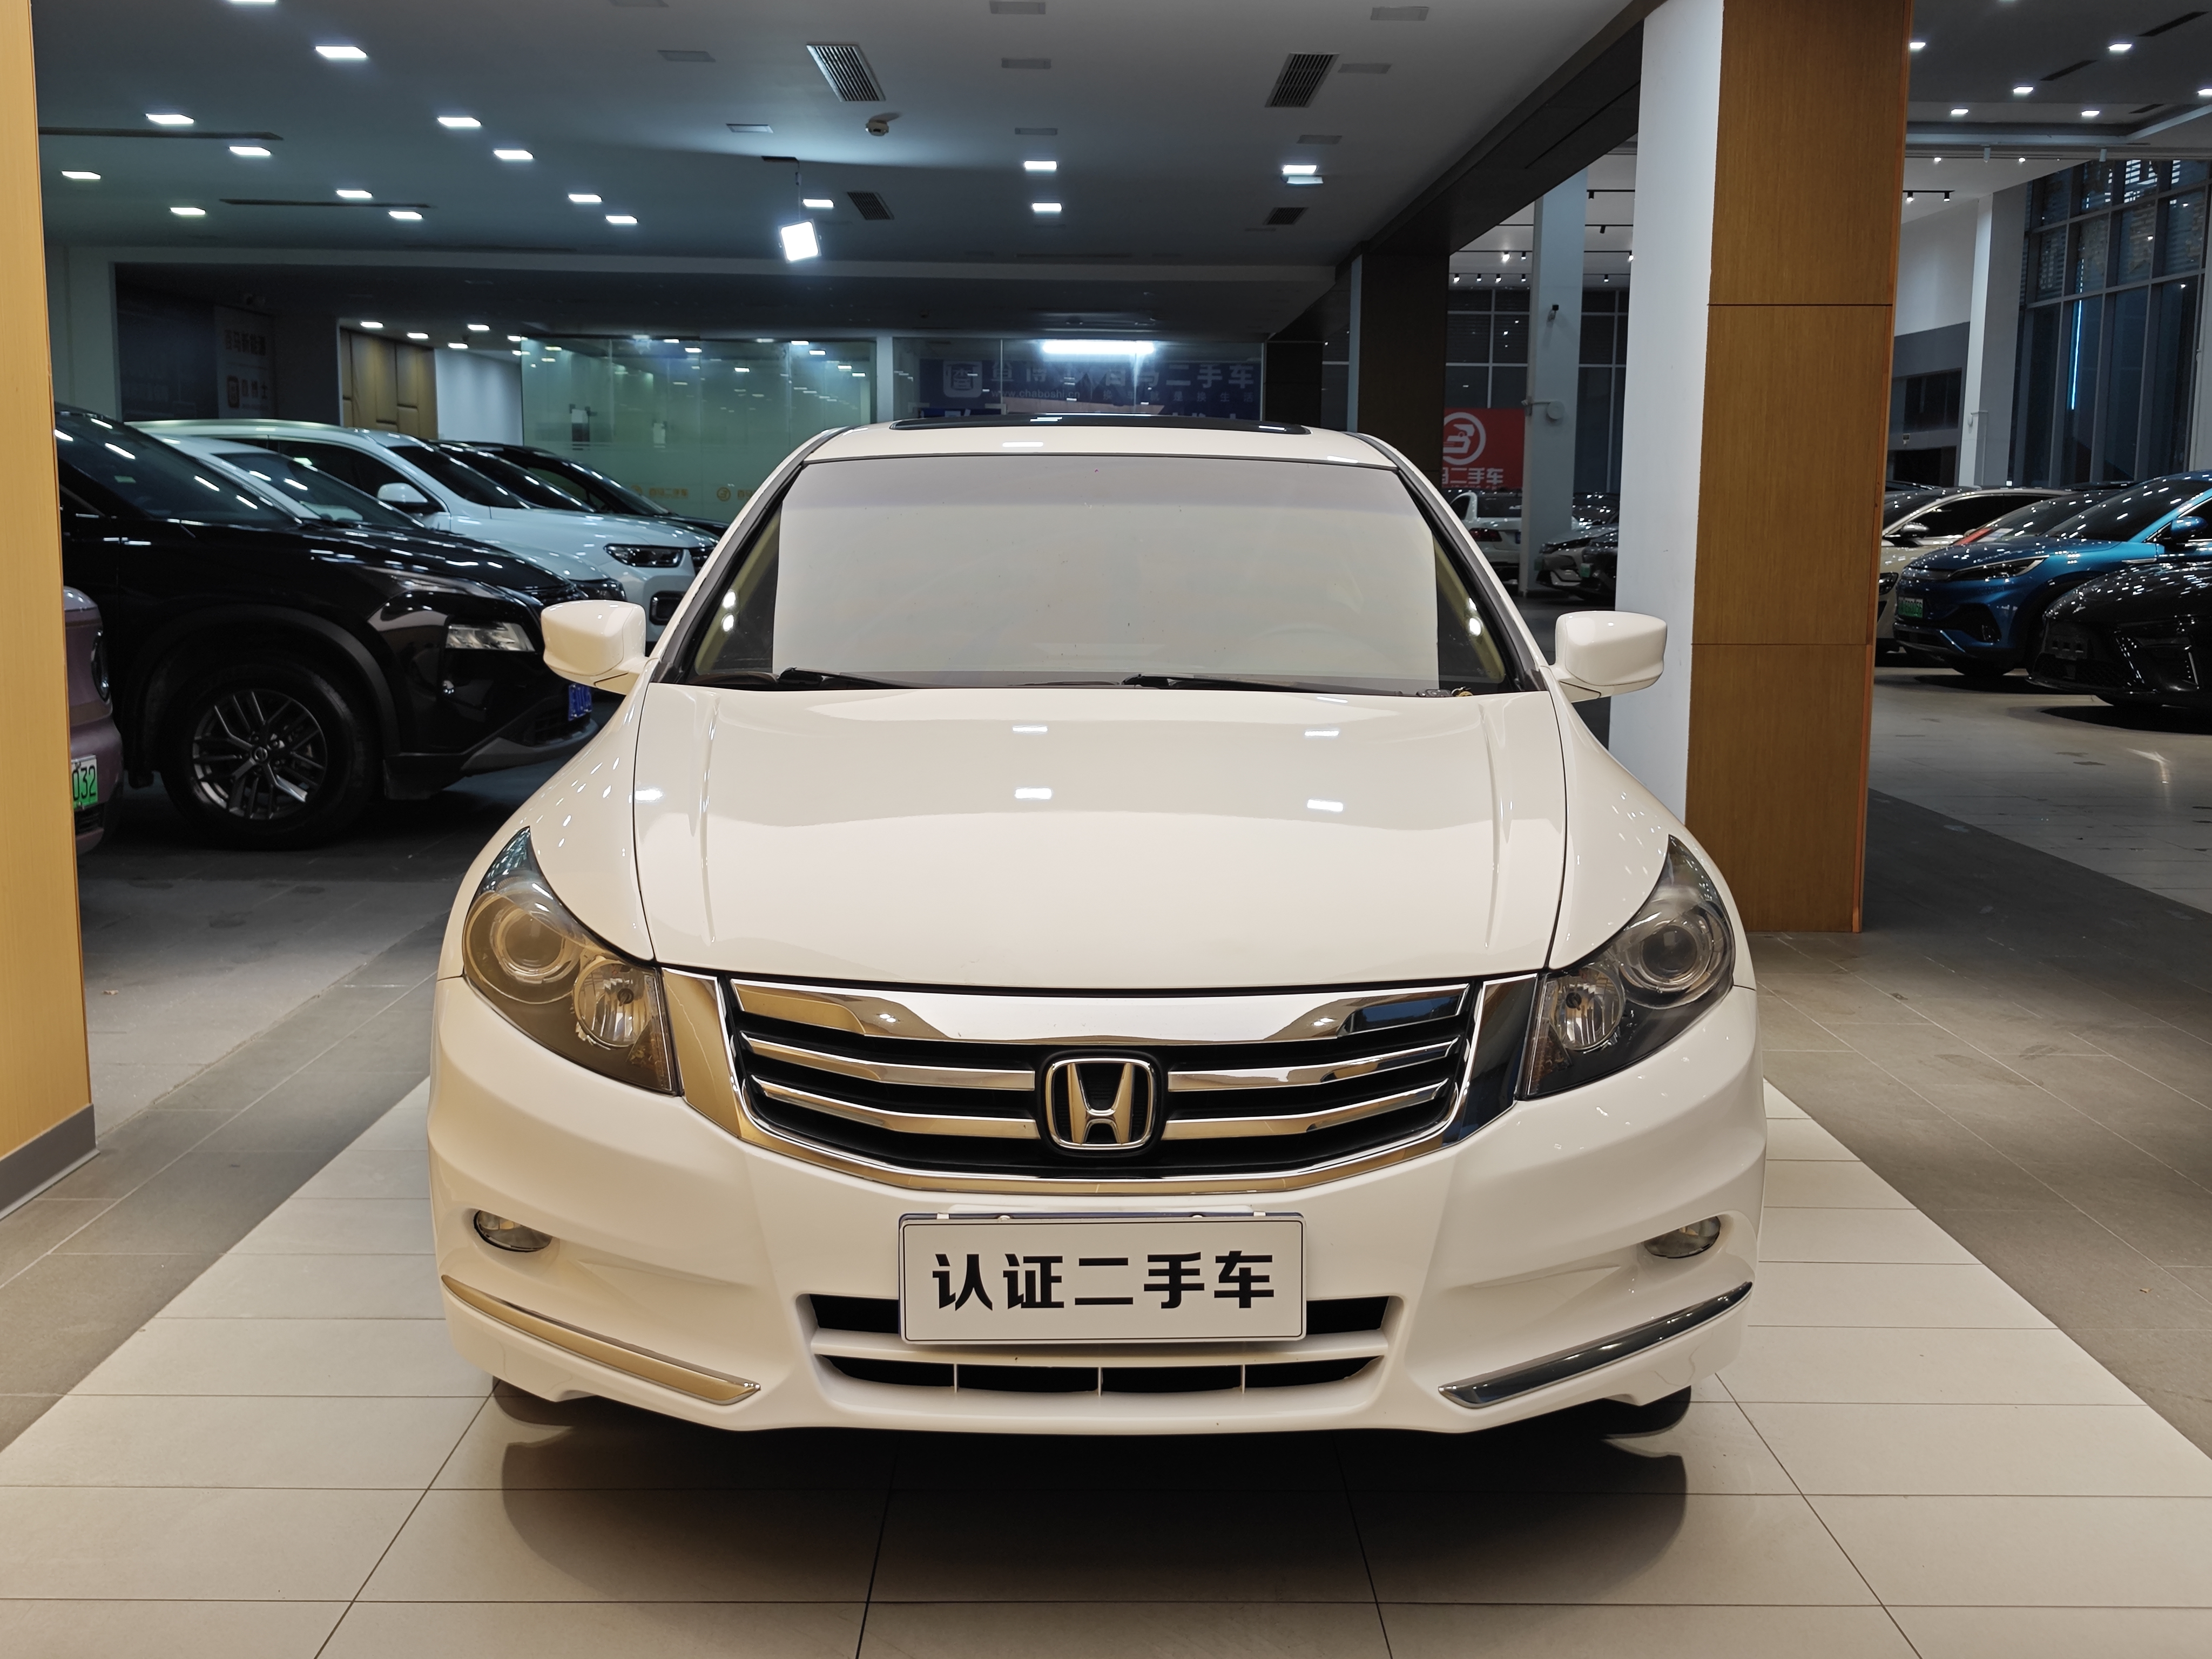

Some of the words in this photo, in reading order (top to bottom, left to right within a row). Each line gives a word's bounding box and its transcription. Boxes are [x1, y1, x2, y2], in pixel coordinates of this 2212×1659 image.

[72, 765, 96, 801] 032
[932, 1250, 1275, 1311] 认证二手车
